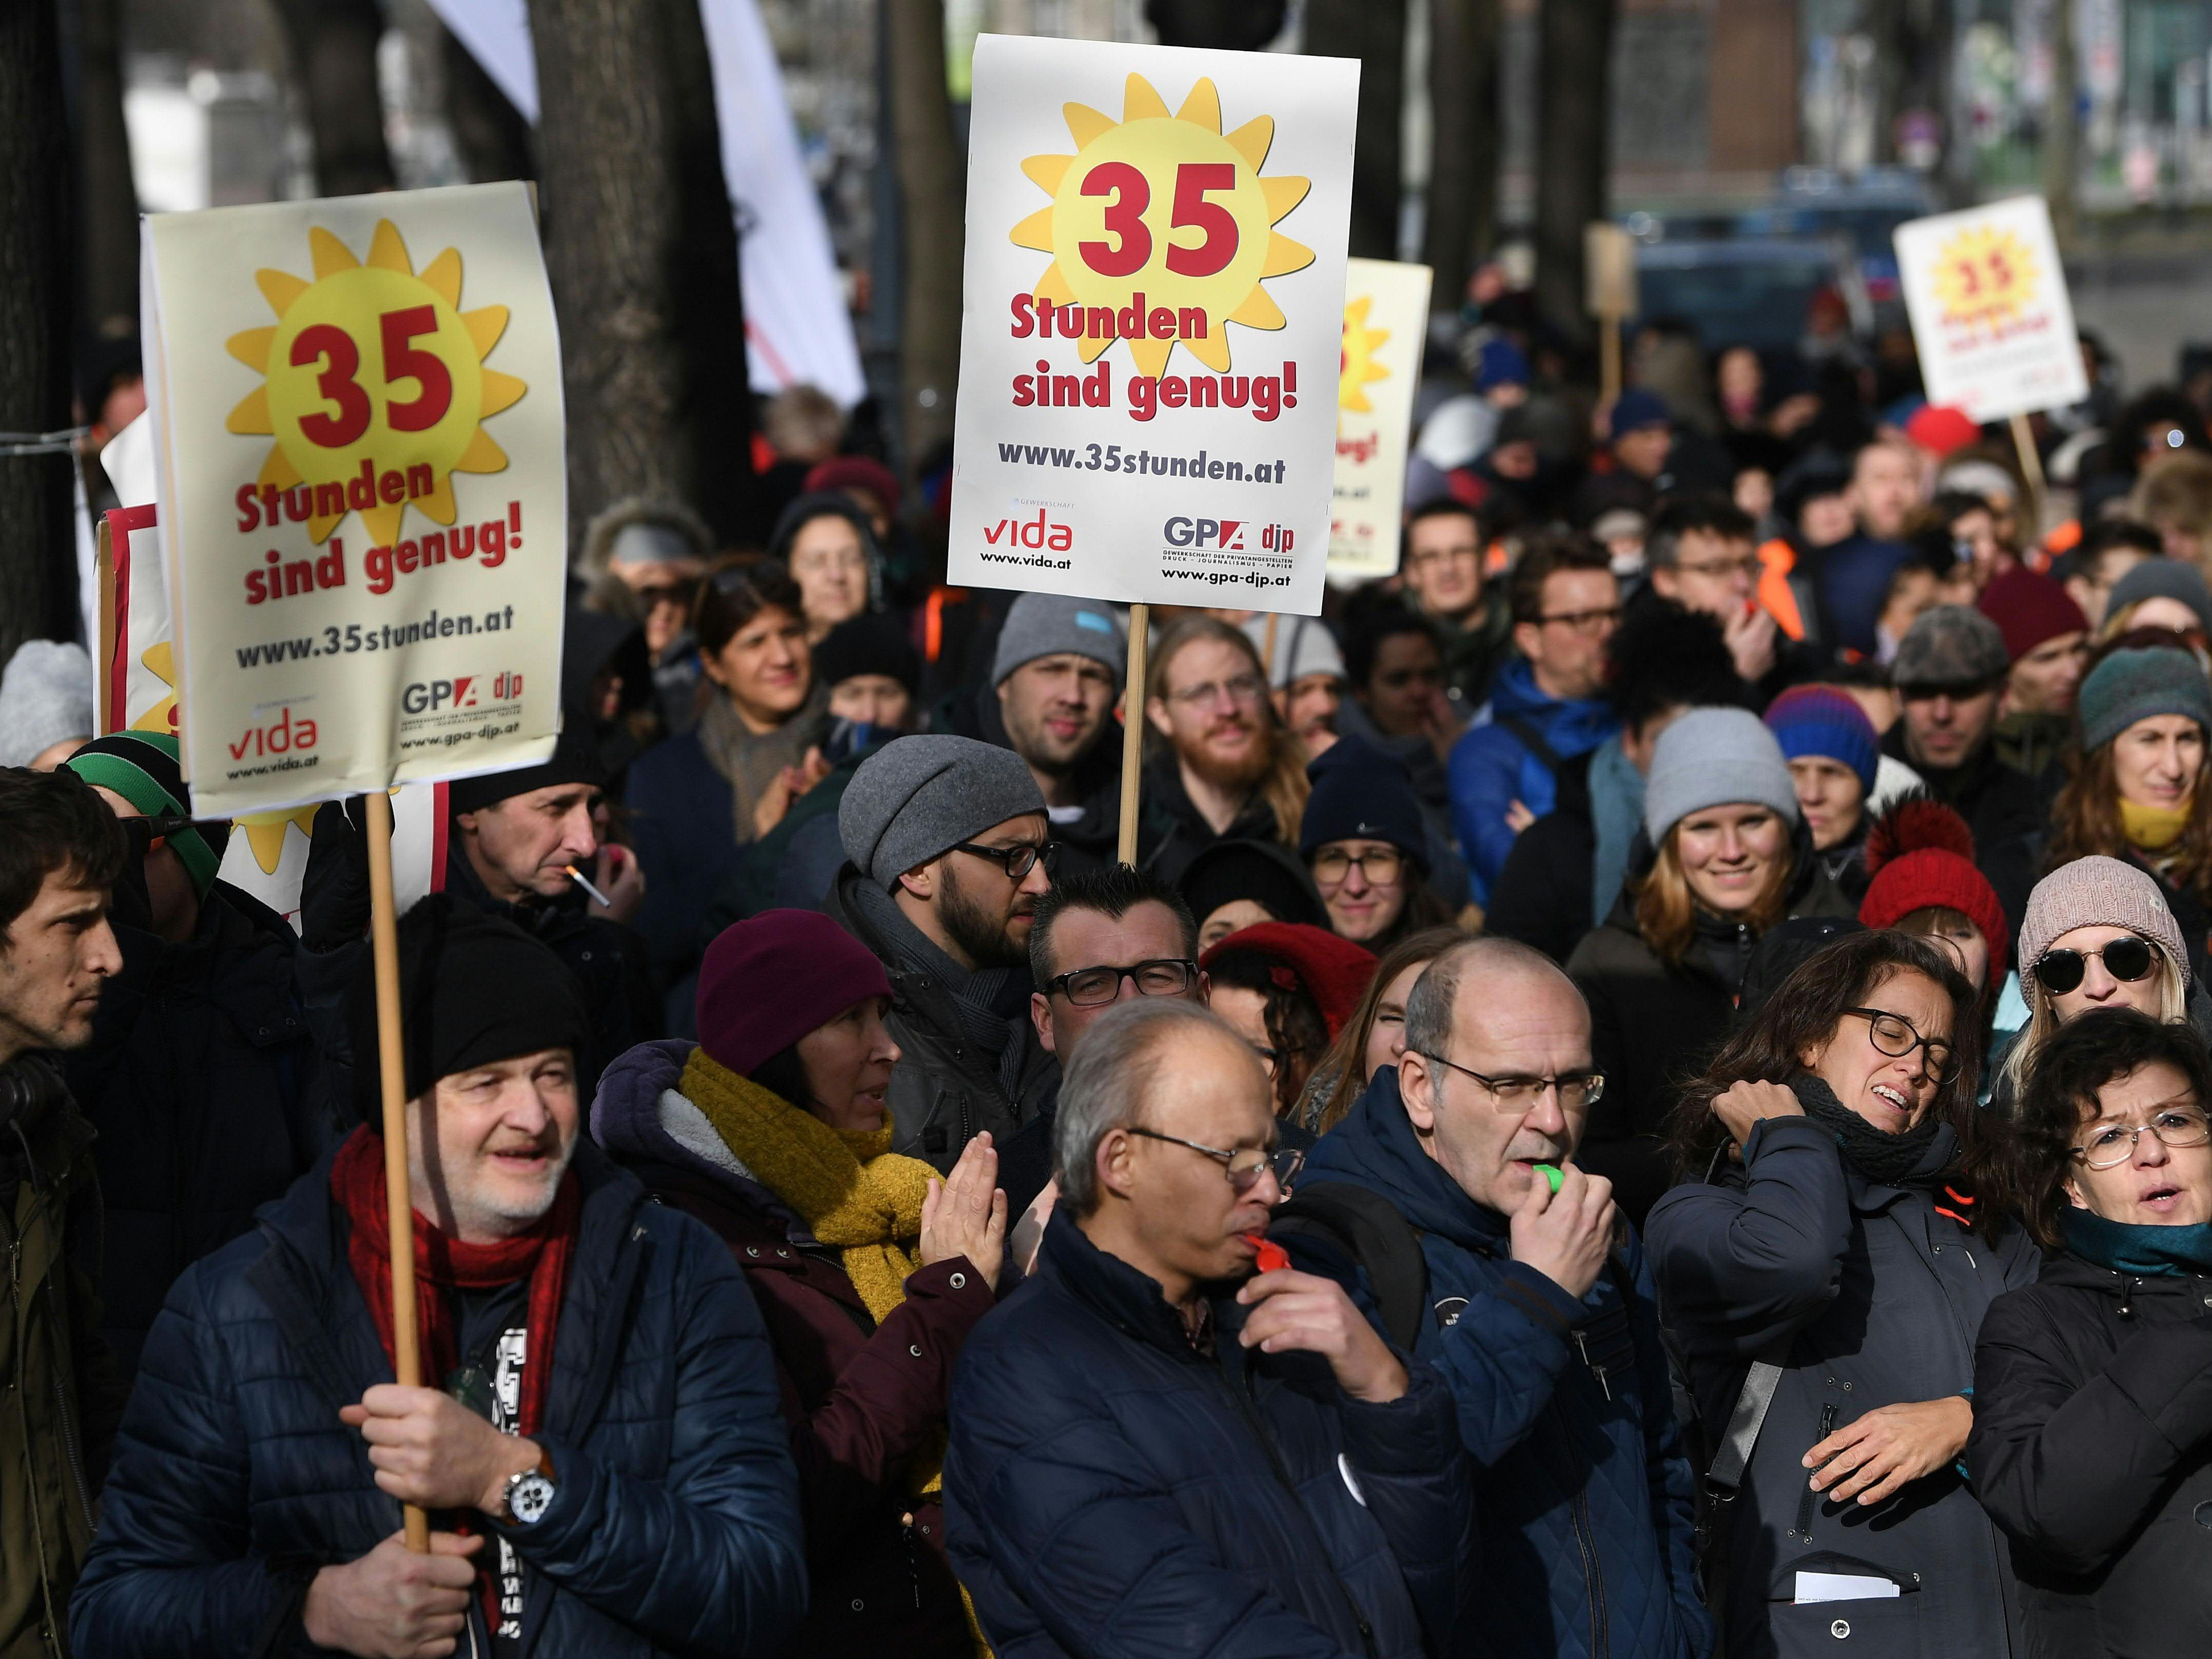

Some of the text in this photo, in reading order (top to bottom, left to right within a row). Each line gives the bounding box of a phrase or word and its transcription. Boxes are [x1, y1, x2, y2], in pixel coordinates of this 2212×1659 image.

[1079, 162, 1239, 277] 35
[1011, 292, 1207, 339] Stunden
[289, 304, 452, 447] 35
[1012, 360, 1297, 421] sind genug!
[998, 442, 1286, 484] www.35stunden.at
[235, 458, 434, 533] Stunden
[1021, 498, 1075, 509] GEWERKSCHAFT
[984, 508, 1072, 551] vida
[1164, 516, 1250, 550] GPA
[1262, 523, 1294, 553] djp
[244, 501, 522, 604] sind genug!
[980, 553, 1071, 569] www.vida.at
[1198, 558, 1256, 567] JOURNALISMUS
[1227, 555, 1293, 563] PRIVATANGESTELLTEN
[1162, 569, 1291, 588] www.gpa-djp.at
[237, 606, 514, 668] www.35stunden.at
[494, 671, 522, 700] djp
[229, 707, 318, 760] vida
[400, 722, 519, 749] www.gpa-djp.at
[227, 756, 319, 779] www.vida.at
